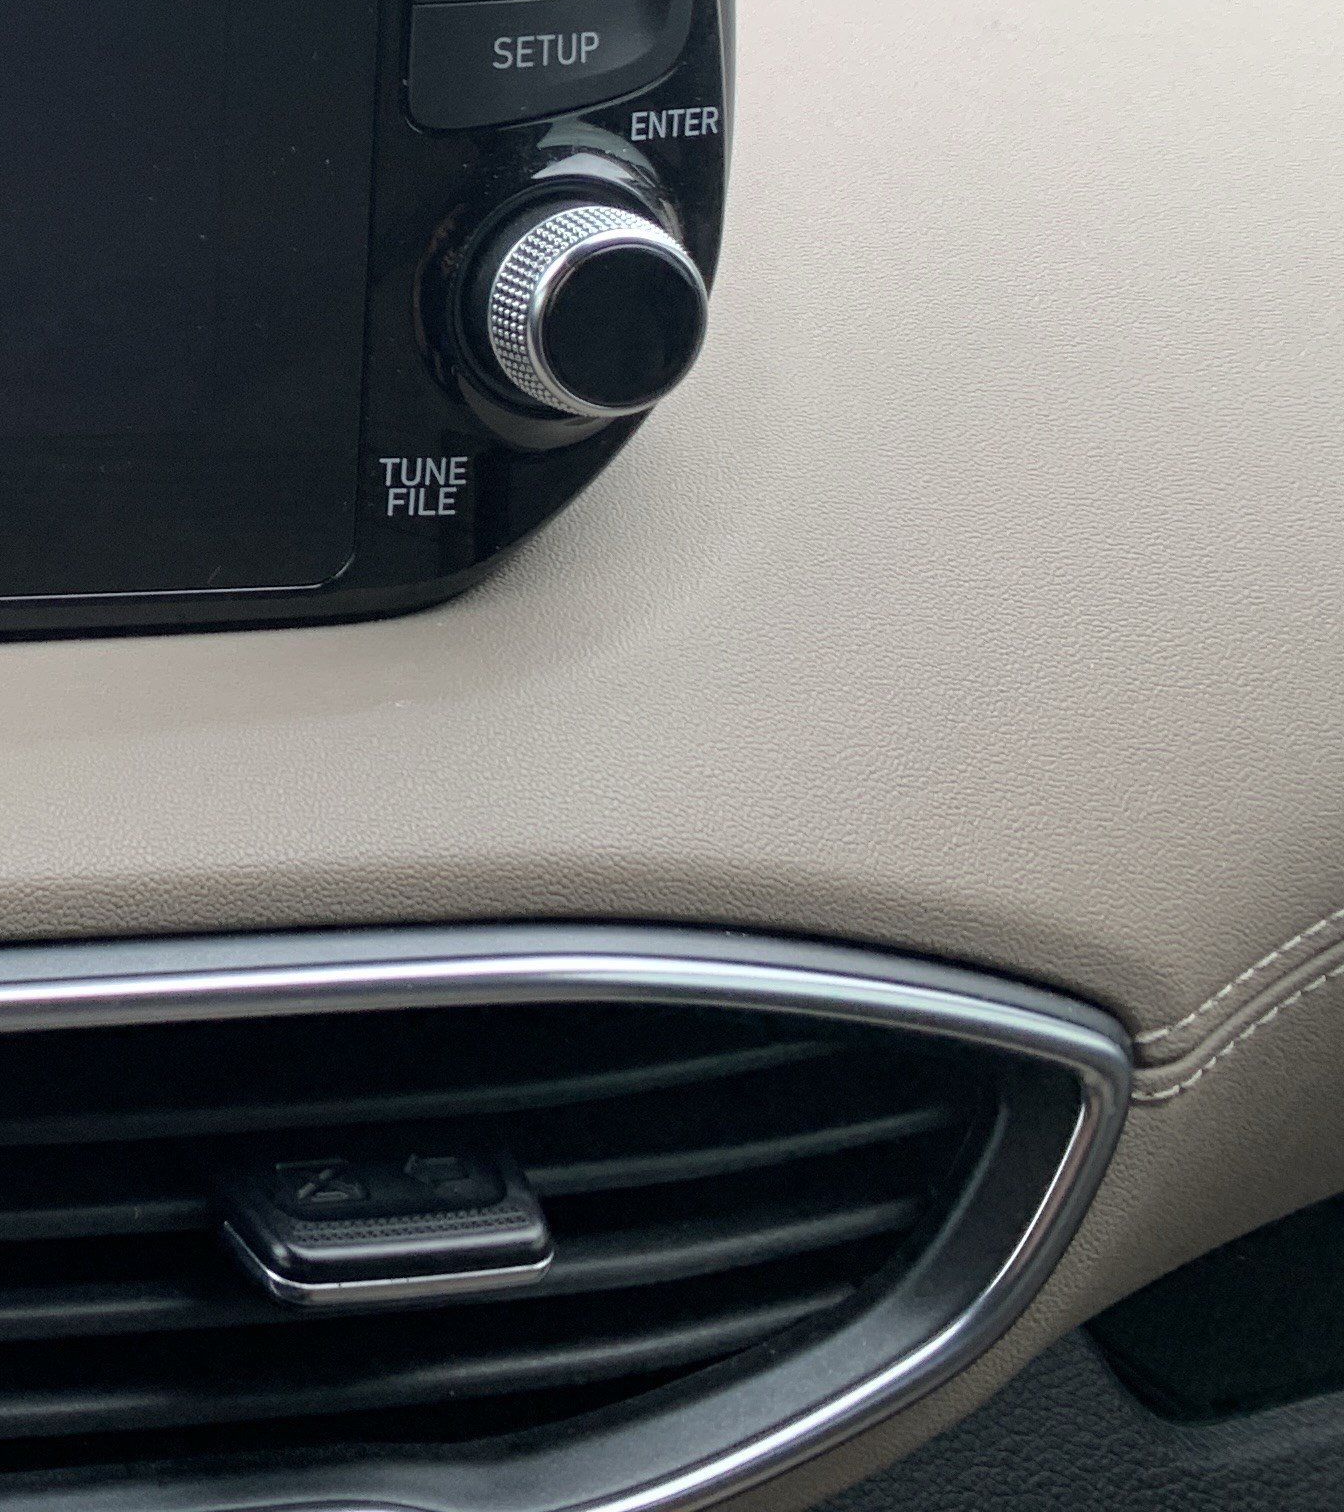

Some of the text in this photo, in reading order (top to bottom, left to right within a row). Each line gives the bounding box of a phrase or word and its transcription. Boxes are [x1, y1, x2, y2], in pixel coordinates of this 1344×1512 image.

[493, 31, 600, 69] SETUP
[630, 106, 720, 141] ENTER
[379, 456, 468, 487] TUNE
[387, 486, 458, 517] FILE
